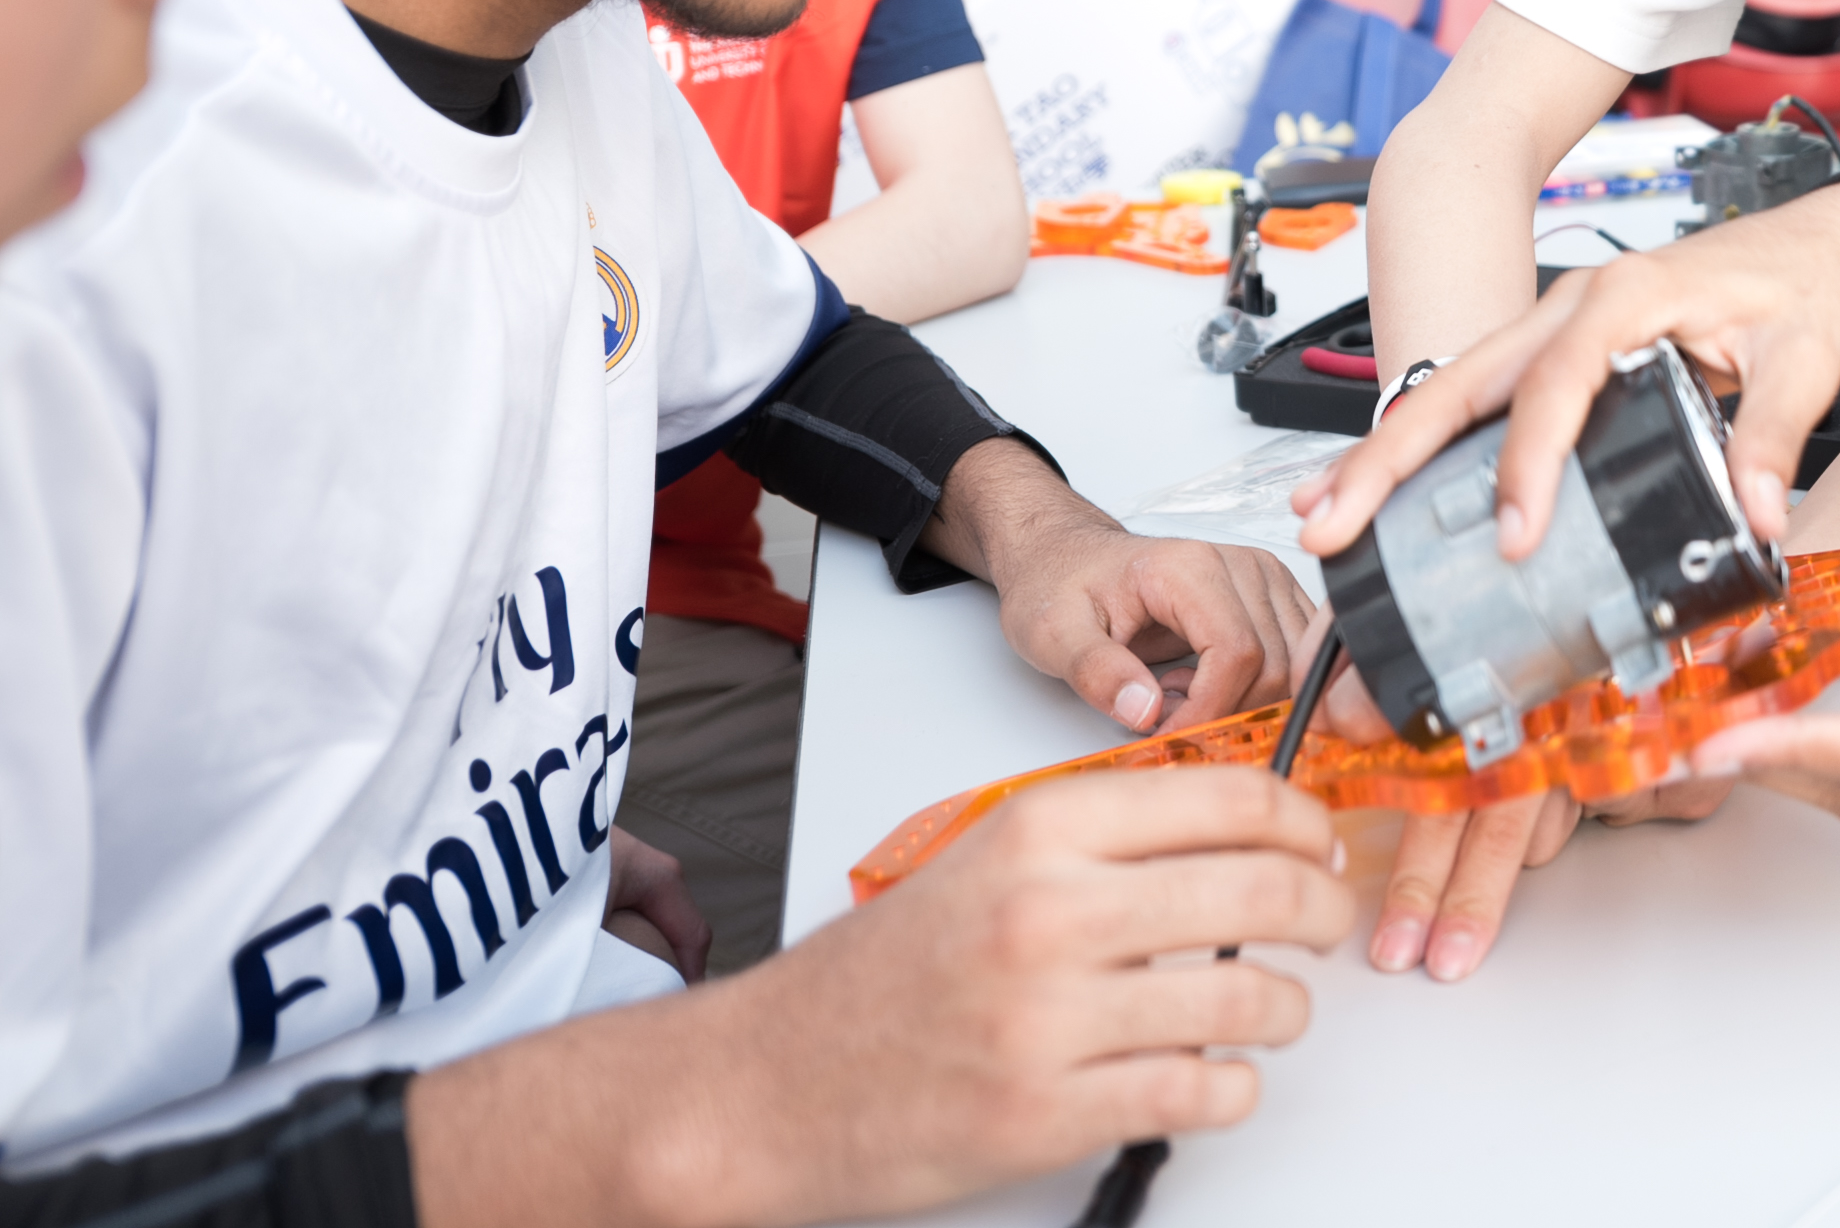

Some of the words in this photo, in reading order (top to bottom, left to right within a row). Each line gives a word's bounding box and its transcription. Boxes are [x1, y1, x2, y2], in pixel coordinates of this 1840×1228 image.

[722, 60, 763, 78] TECHN
[1011, 80, 1110, 166] NDARY
[232, 714, 628, 1076] Emira
